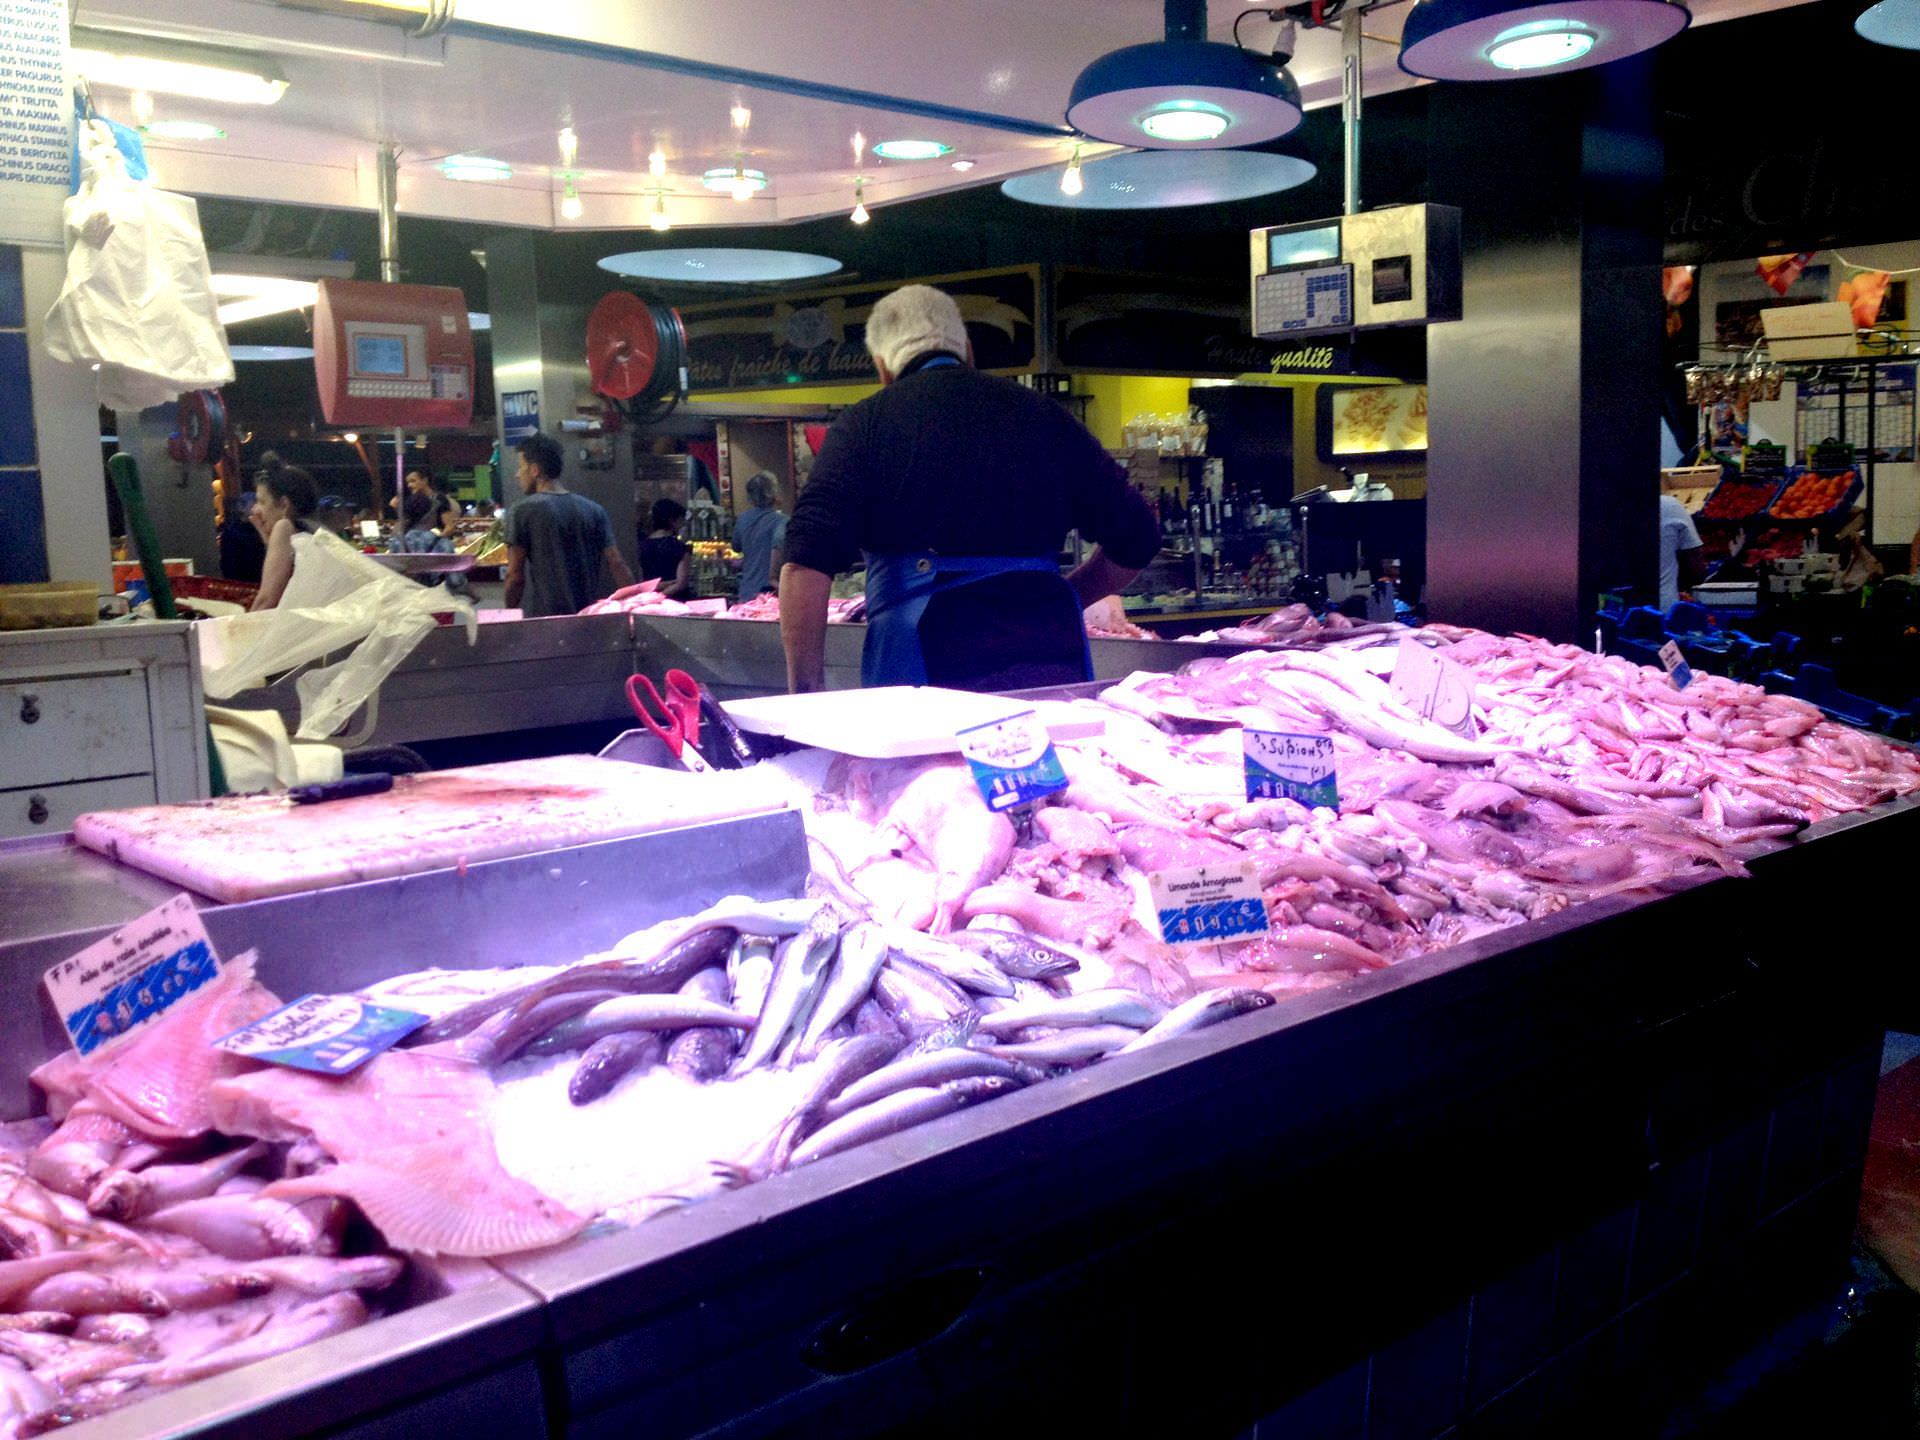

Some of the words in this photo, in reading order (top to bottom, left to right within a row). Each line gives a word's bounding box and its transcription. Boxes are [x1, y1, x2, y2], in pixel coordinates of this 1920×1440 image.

[15, 70, 63, 83] PAGURUS
[21, 96, 58, 109] TRUTTA
[16, 109, 61, 121] MAXIMA
[28, 123, 68, 135] MAXIMUS
[35, 162, 70, 174] DRACO
[799, 350, 822, 374] de
[1269, 346, 1334, 374] qualité
[513, 391, 538, 416] WC
[1168, 880, 1200, 892] Limande
[80, 969, 99, 985] Aile
[101, 960, 115, 972] de
